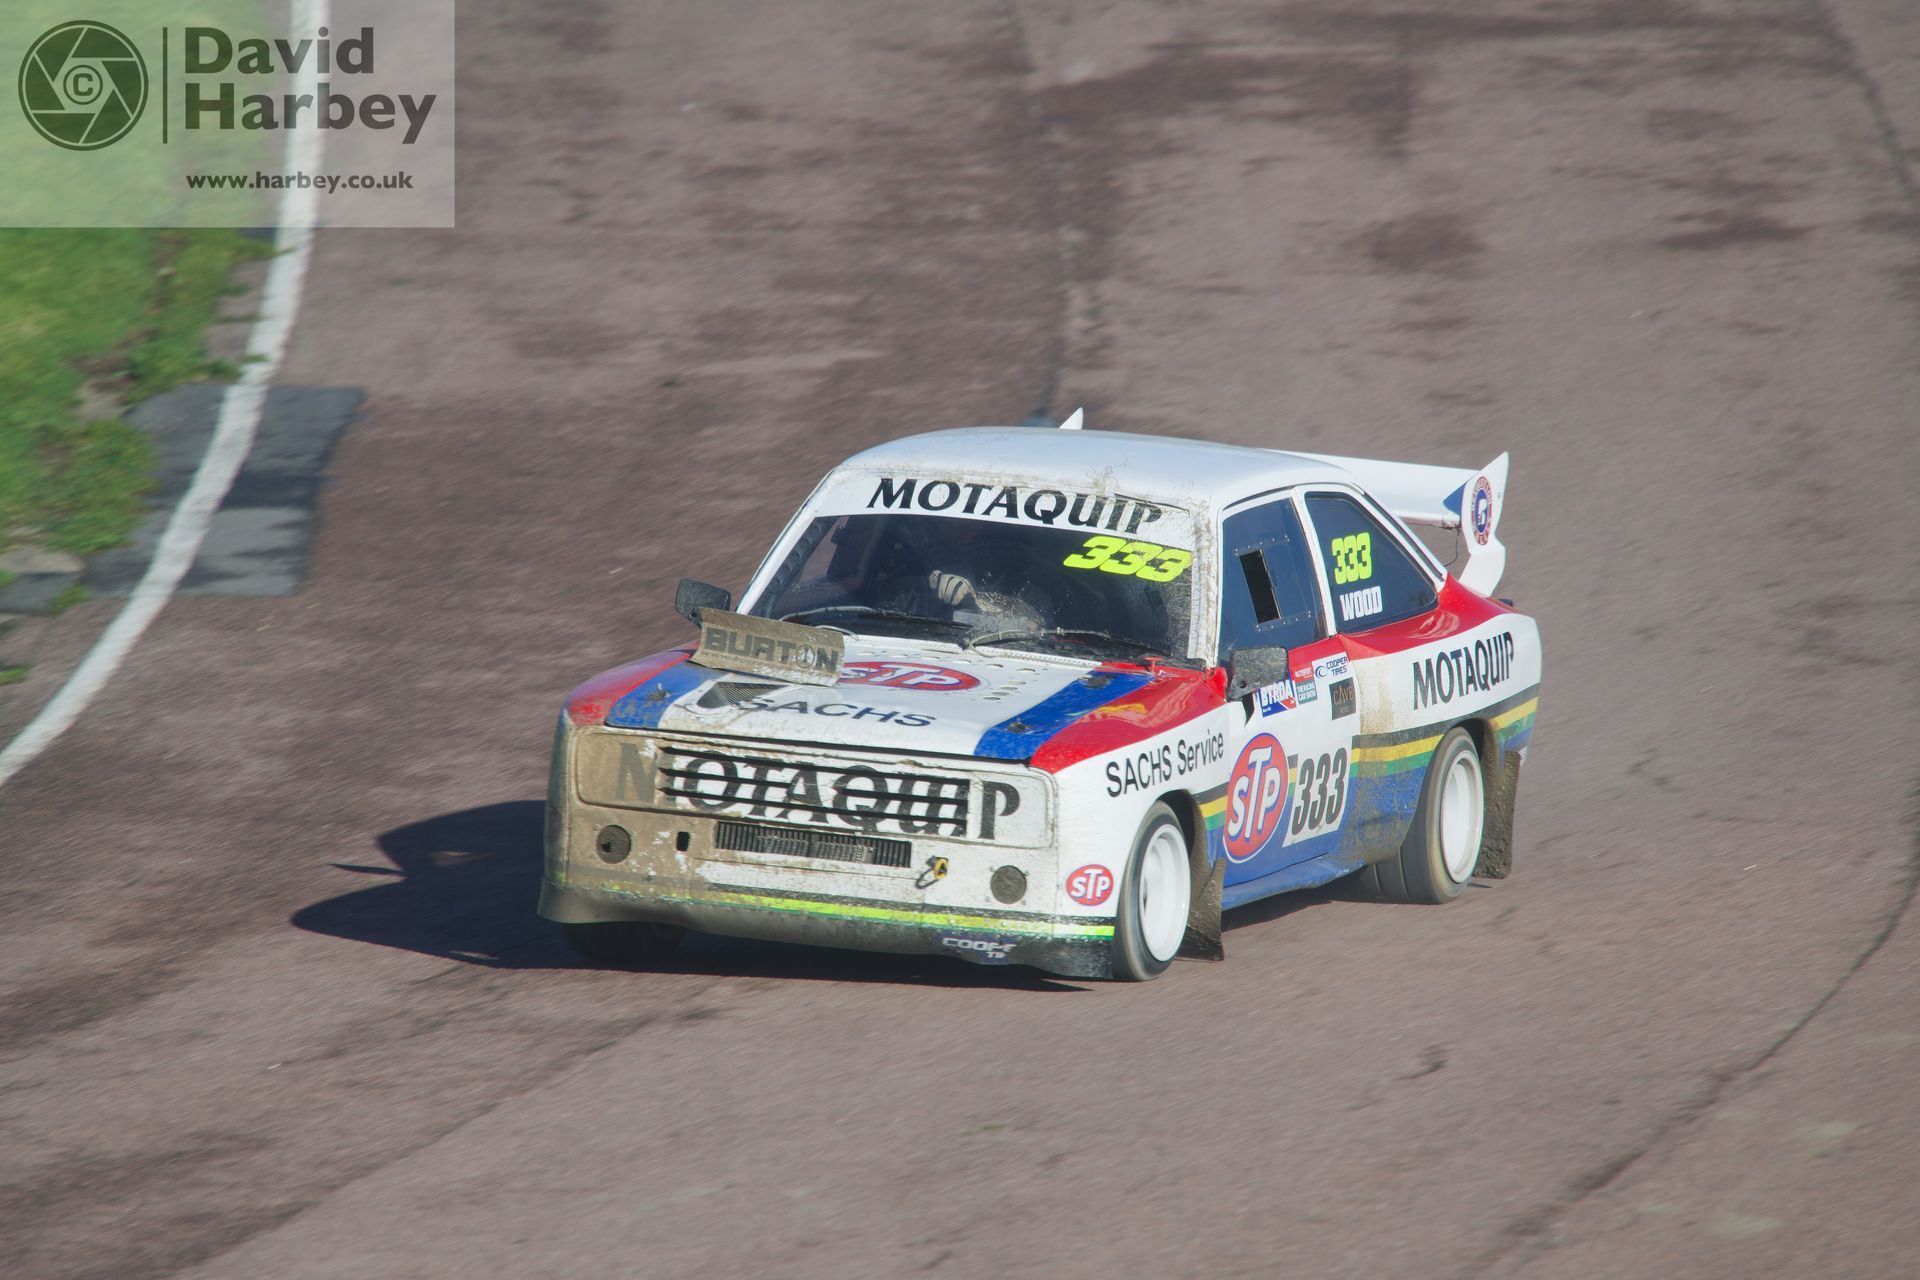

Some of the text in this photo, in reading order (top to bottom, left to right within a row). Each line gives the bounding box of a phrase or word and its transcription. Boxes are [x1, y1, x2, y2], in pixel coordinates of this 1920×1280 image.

[867, 478, 1163, 534] MOTAQUIP
[1063, 536, 1193, 582] 333
[1331, 532, 1372, 585] 333
[1340, 586, 1383, 621] WOOD
[705, 627, 841, 673] BURTON
[1326, 657, 1347, 669] COOPER
[1331, 665, 1347, 676] TIRES
[1412, 631, 1514, 711] MOTAQUIP
[842, 664, 961, 686] STP
[1260, 679, 1293, 706] BTRDA
[738, 699, 937, 727] SACHS
[1106, 729, 1224, 797] SACHS Service
[1228, 745, 1281, 839] STP
[1291, 747, 1348, 836] 333
[1070, 868, 1110, 900] STP
